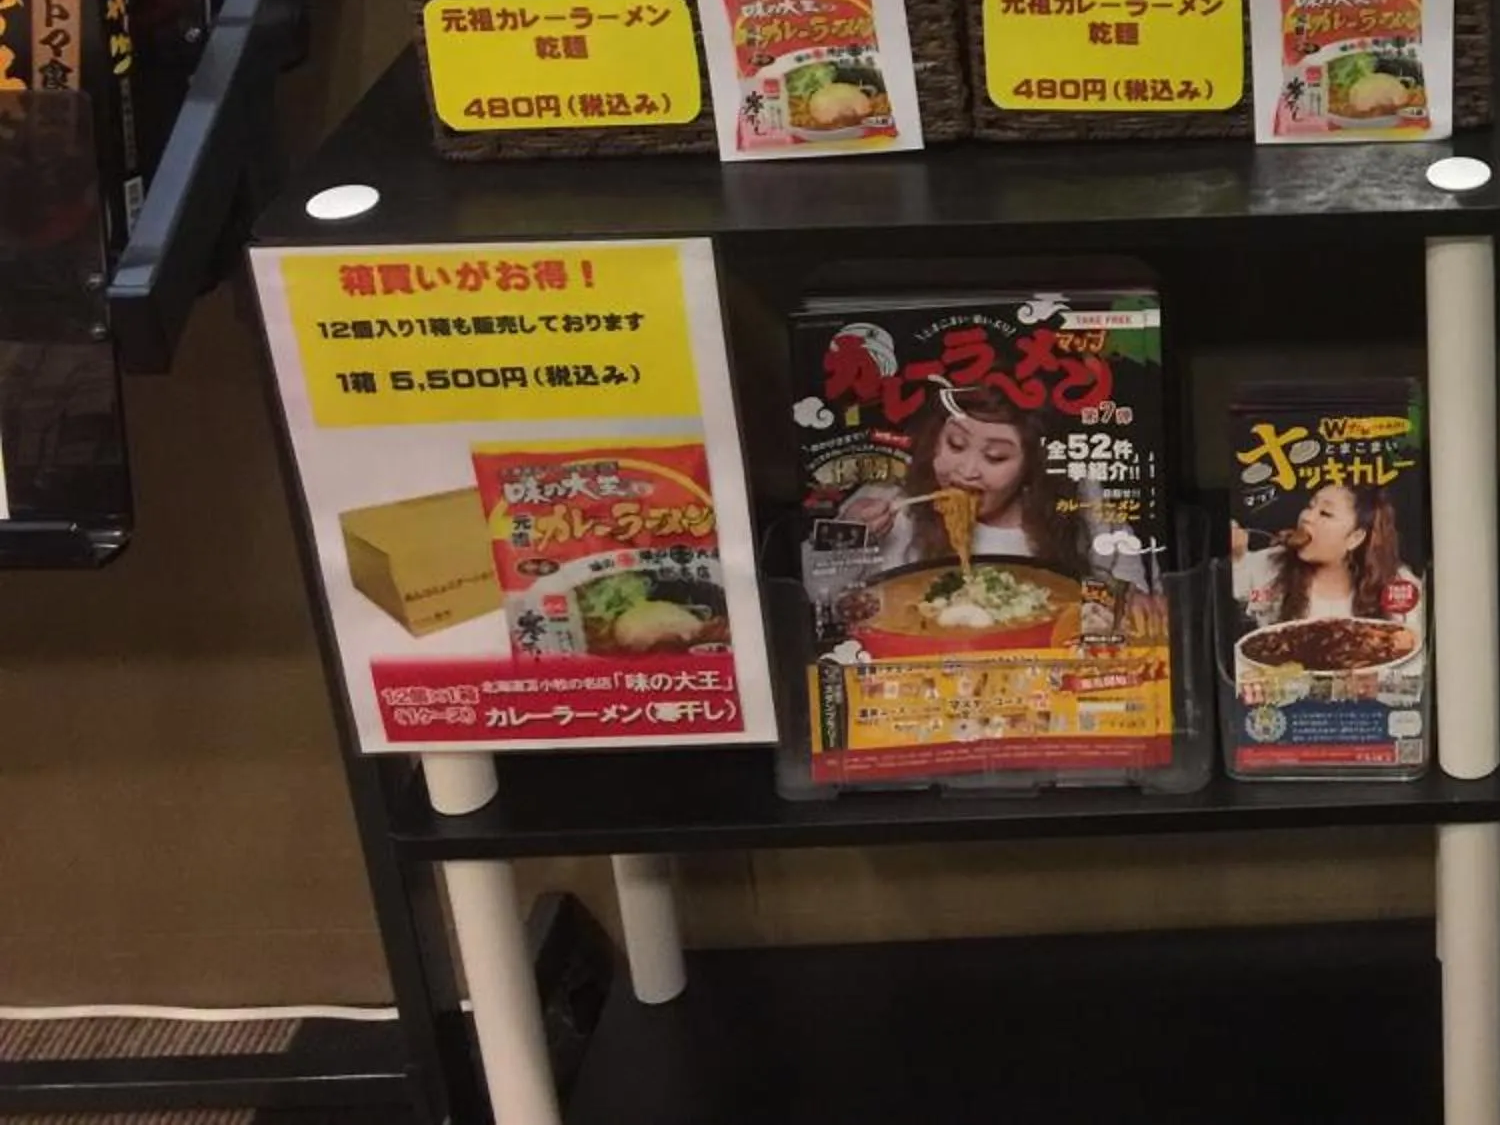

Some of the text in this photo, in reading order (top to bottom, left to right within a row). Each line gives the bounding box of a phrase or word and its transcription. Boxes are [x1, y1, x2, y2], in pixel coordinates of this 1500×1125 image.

[441, 5, 672, 33] 元祖カレーラーメン
[1088, 21, 1140, 46] 乾麺
[535, 35, 589, 60] 乾麺
[317, 312, 645, 340] 12個入り1箱も販売しております
[336, 371, 378, 394] 1箱
